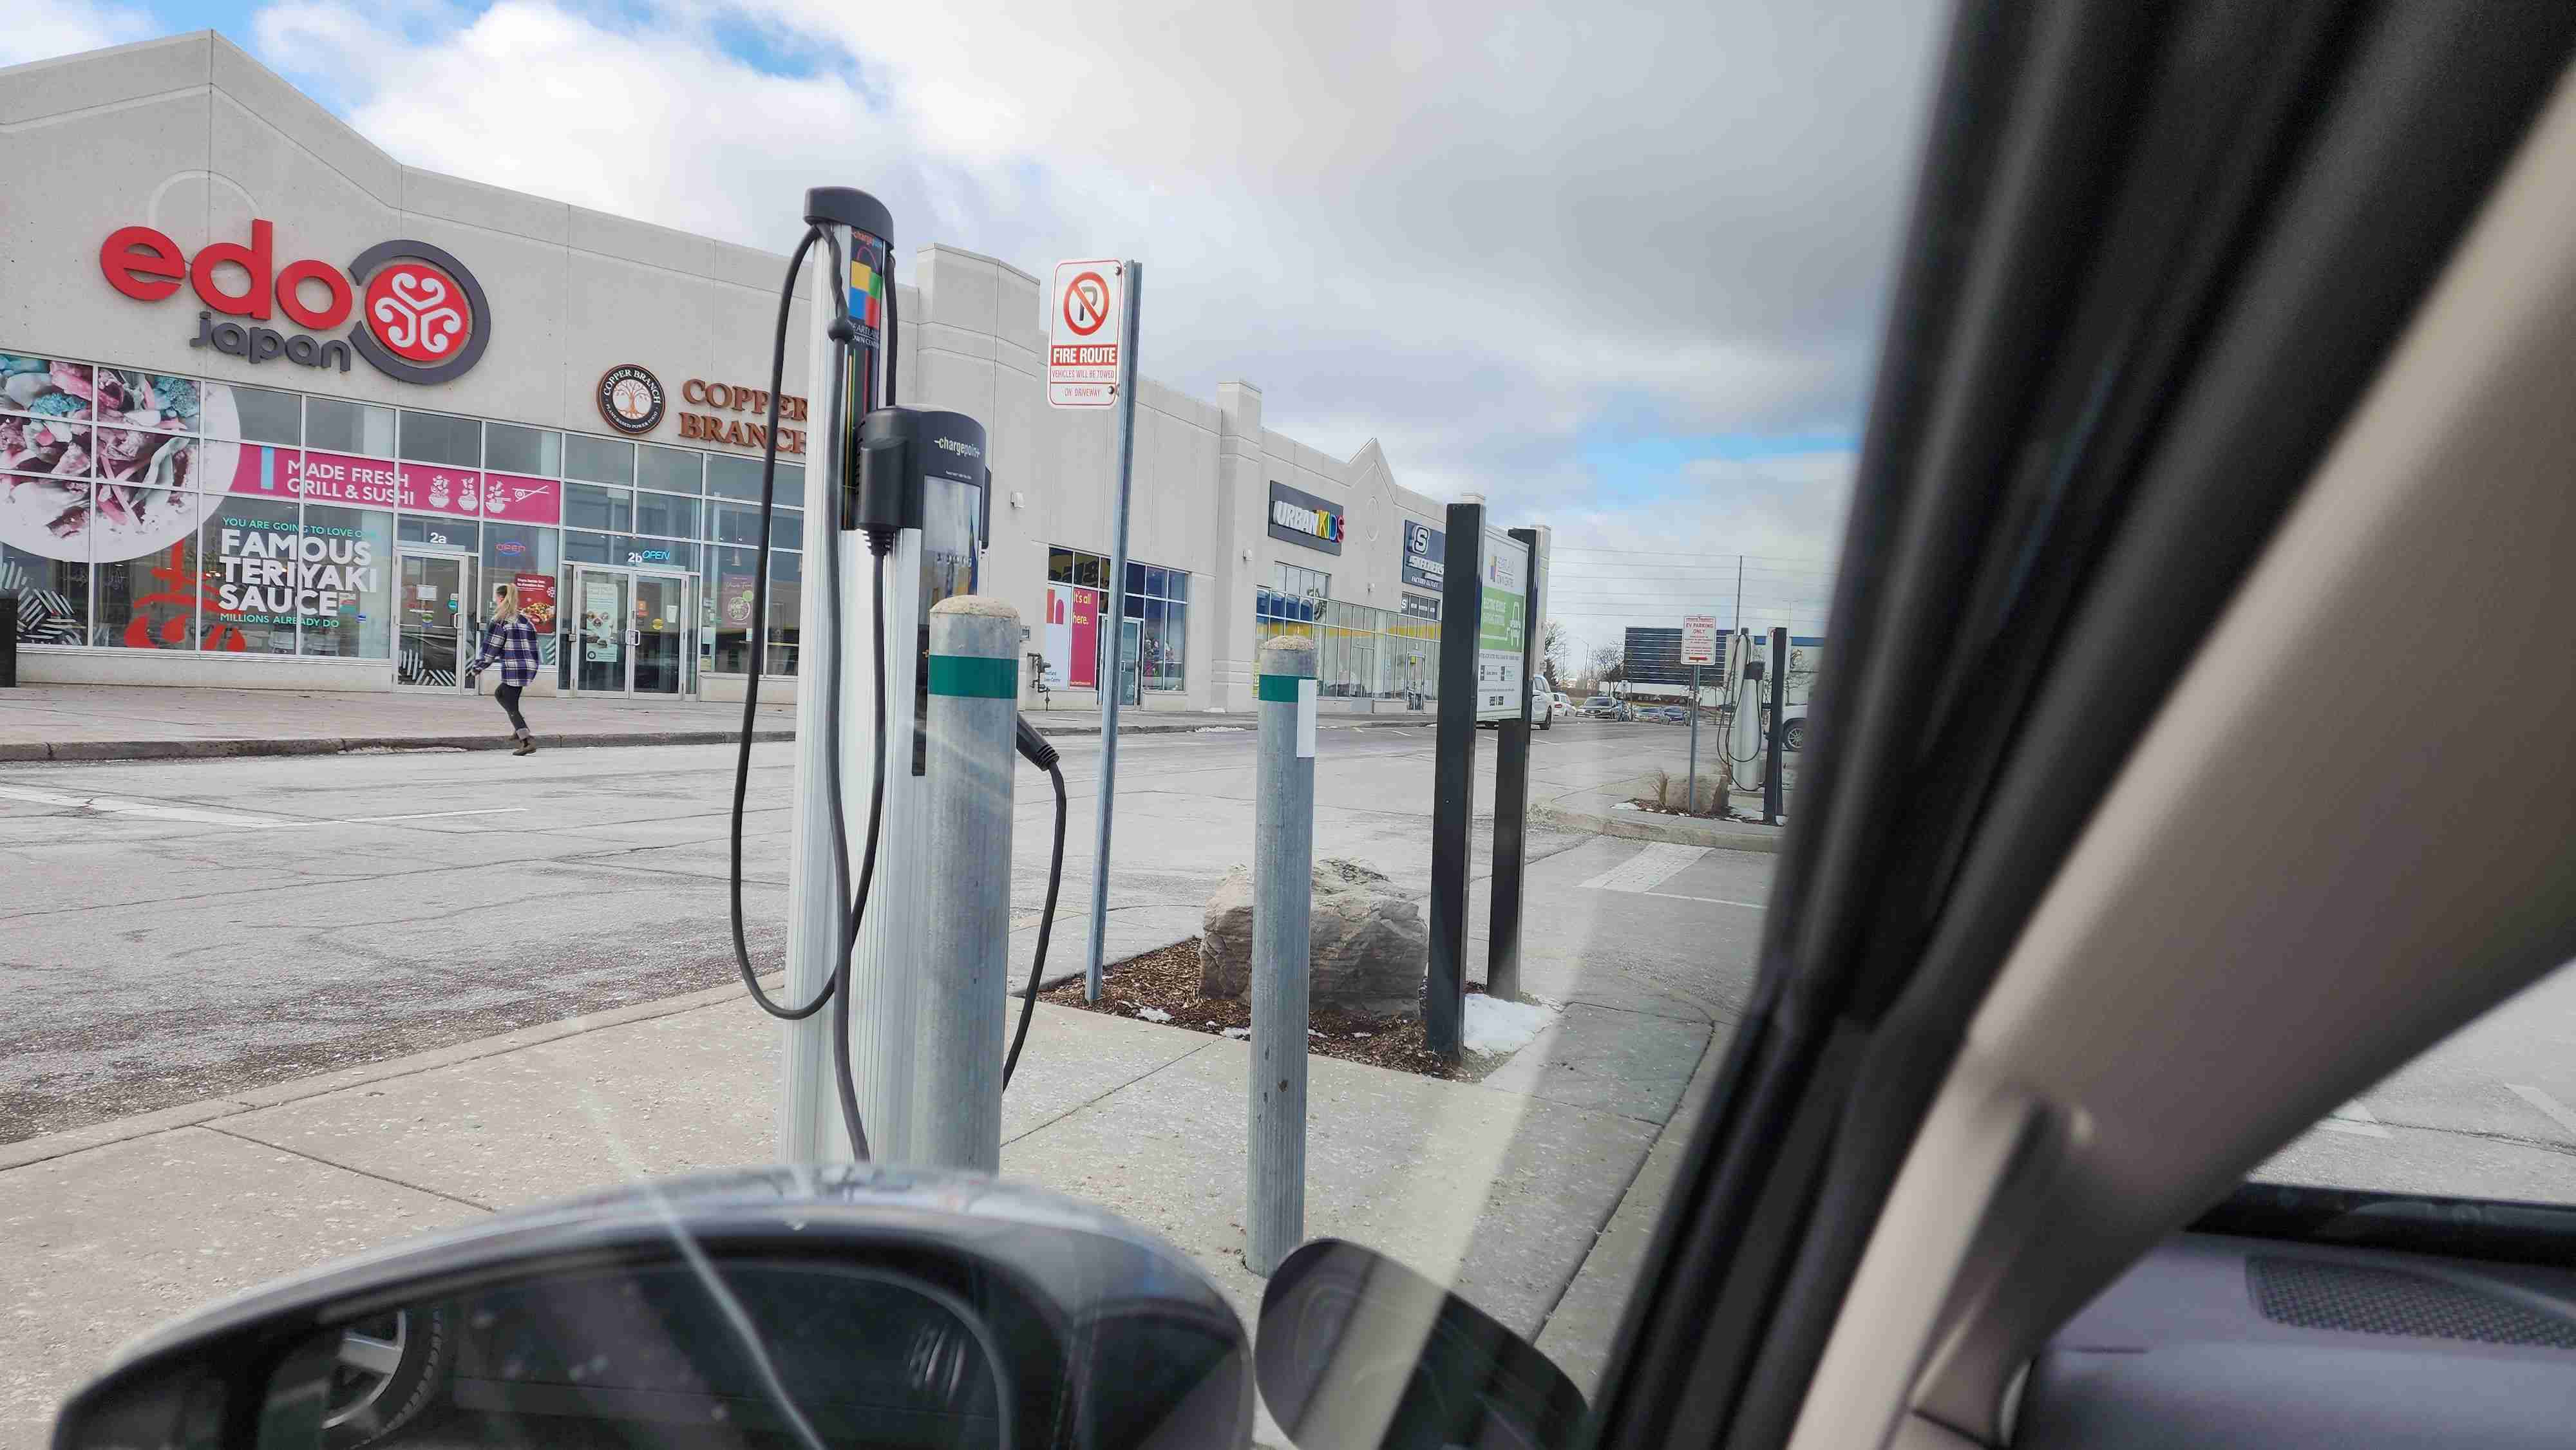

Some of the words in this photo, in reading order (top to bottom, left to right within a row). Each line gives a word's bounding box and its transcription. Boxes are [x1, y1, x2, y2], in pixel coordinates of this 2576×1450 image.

[100, 219, 353, 330] edo
[189, 311, 351, 373] japan
[1053, 348, 1077, 364] FIRE
[1079, 347, 1116, 363] ROUTE
[1052, 370, 1075, 379] VEHICLES
[1076, 370, 1088, 379] WILL
[1090, 370, 1096, 379] BE
[1097, 370, 1113, 379] TOWED
[603, 369, 632, 397] COPPER
[633, 370, 661, 404] BRANCH
[1074, 388, 1100, 397] DRIVEWAY
[683, 379, 808, 422] COPPER
[288, 460, 345, 480] MADE
[352, 467, 409, 487] FRESH
[287, 478, 342, 498] GRILL
[345, 484, 359, 500] &
[363, 487, 414, 505] SUSHI
[222, 517, 246, 527] YOU
[249, 520, 270, 529] ARE
[310, 525, 325, 534] TO
[327, 527, 353, 537] LOVE
[221, 528, 372, 566] FAMOUS
[430, 532, 448, 544] 2a
[495, 543, 526, 552] OPEN
[627, 552, 643, 563] 2b
[643, 550, 670, 561] OPEN
[220, 556, 377, 593] TERIYAKI
[218, 584, 338, 617] SAUCE
[220, 613, 269, 623] MILLIONS
[273, 616, 320, 626] ALREADY
[322, 619, 339, 628] DO
[1073, 612, 1089, 625] here.
